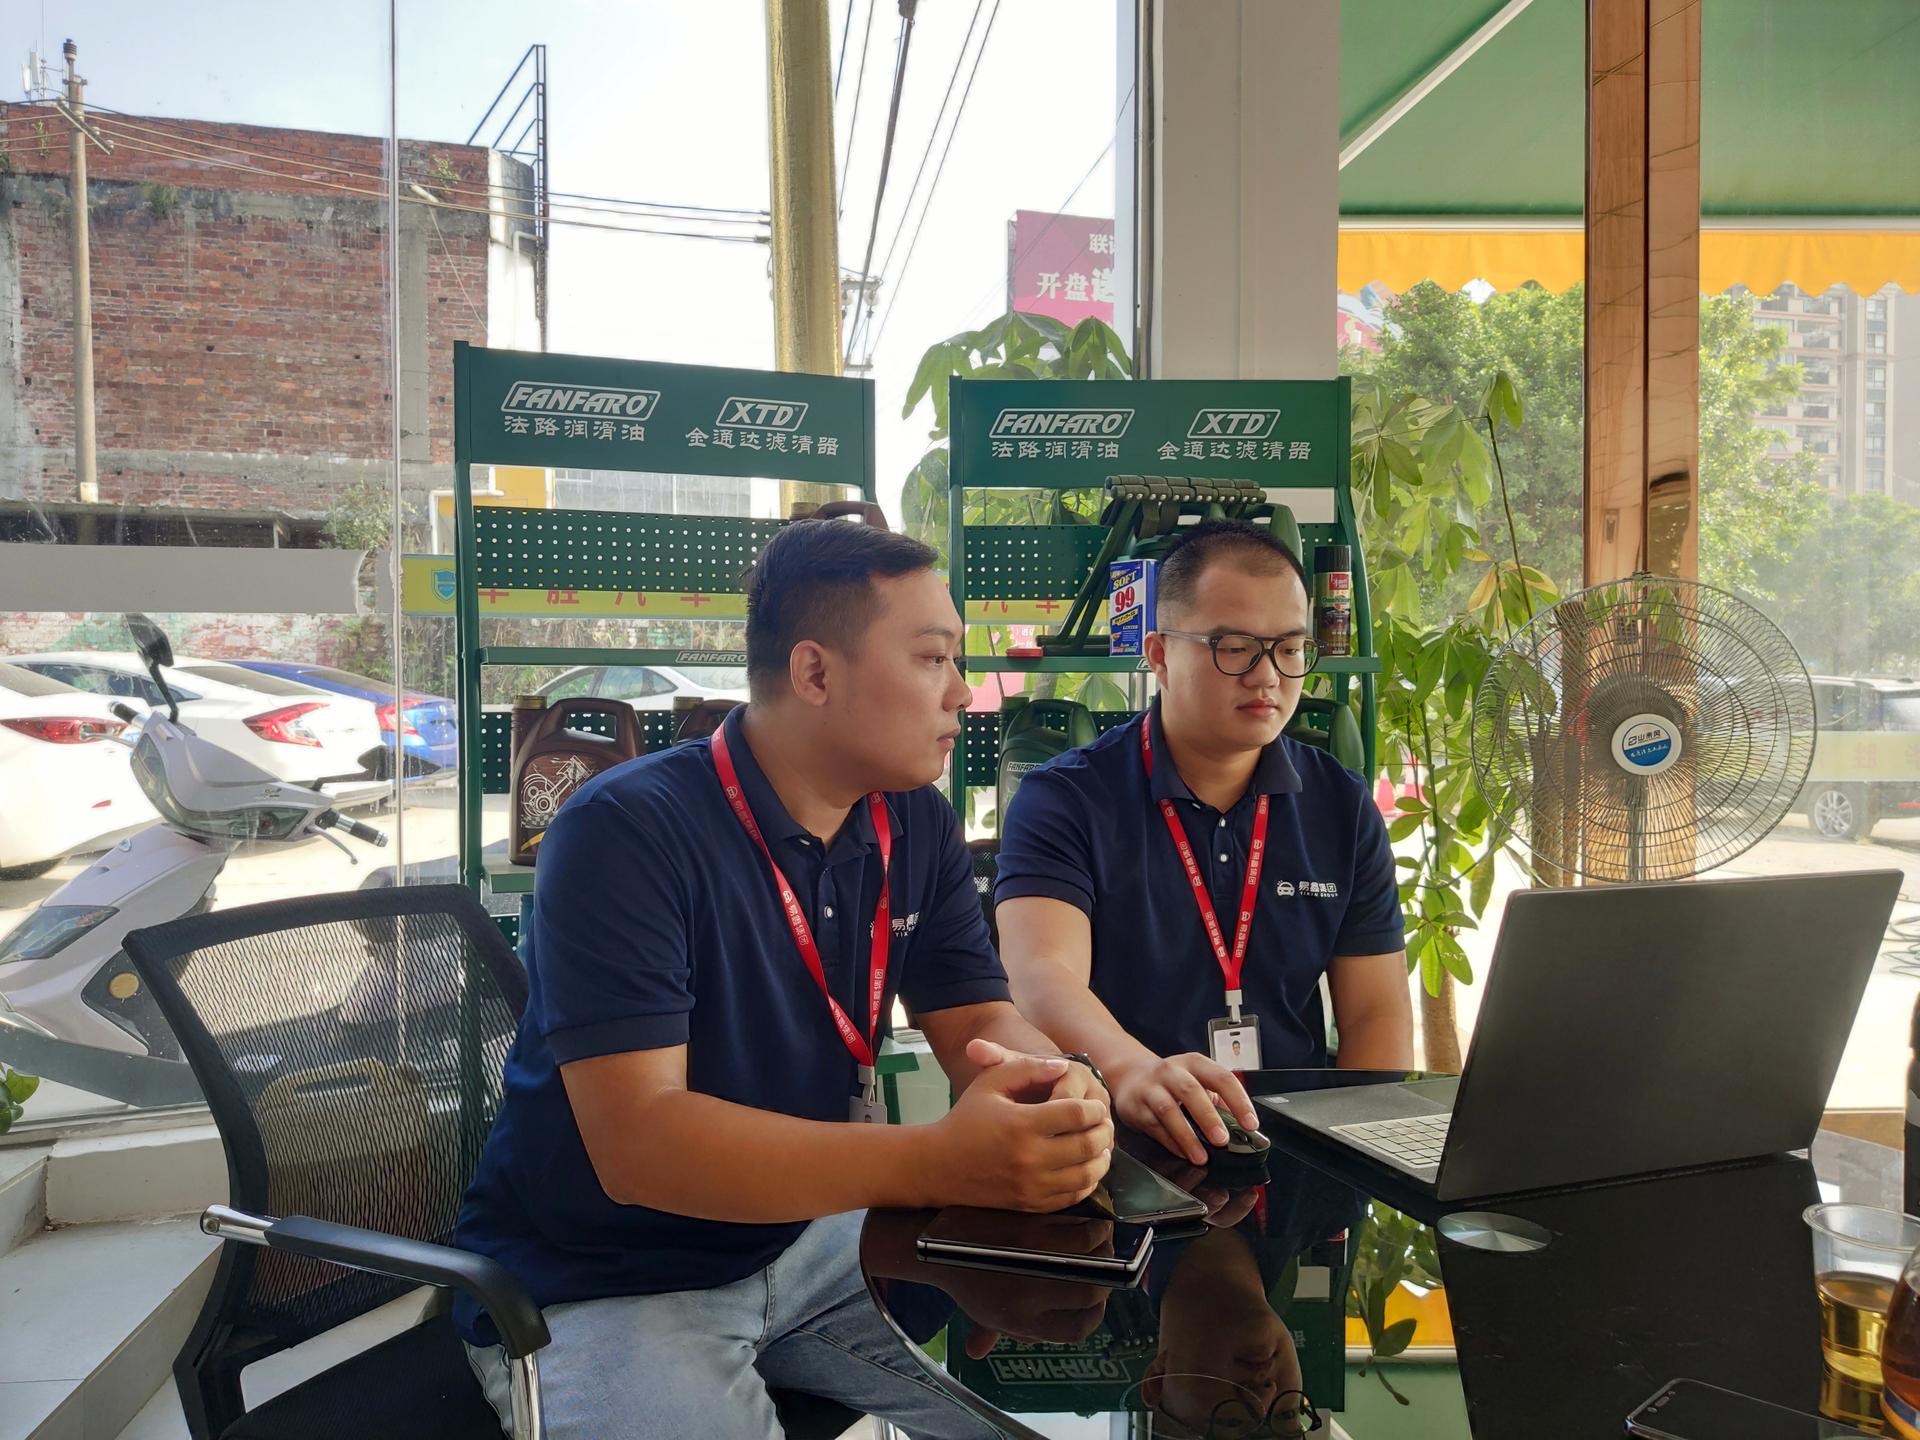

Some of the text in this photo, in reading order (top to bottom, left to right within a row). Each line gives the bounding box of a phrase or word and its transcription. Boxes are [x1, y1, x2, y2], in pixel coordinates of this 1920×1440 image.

[508, 386, 649, 418] FANFARO
[729, 401, 795, 427] XTD
[503, 415, 646, 443] 法路润滑油
[998, 412, 1125, 436] FANFARO
[1204, 412, 1267, 436] XTD
[685, 427, 840, 457] 金通达滤清器
[991, 441, 1121, 460] 法路润滑油
[1157, 441, 1312, 461] 金通达滤清器
[1113, 571, 1137, 590] SOFT
[1115, 586, 1135, 613] 99
[680, 653, 748, 662] FANFARO
